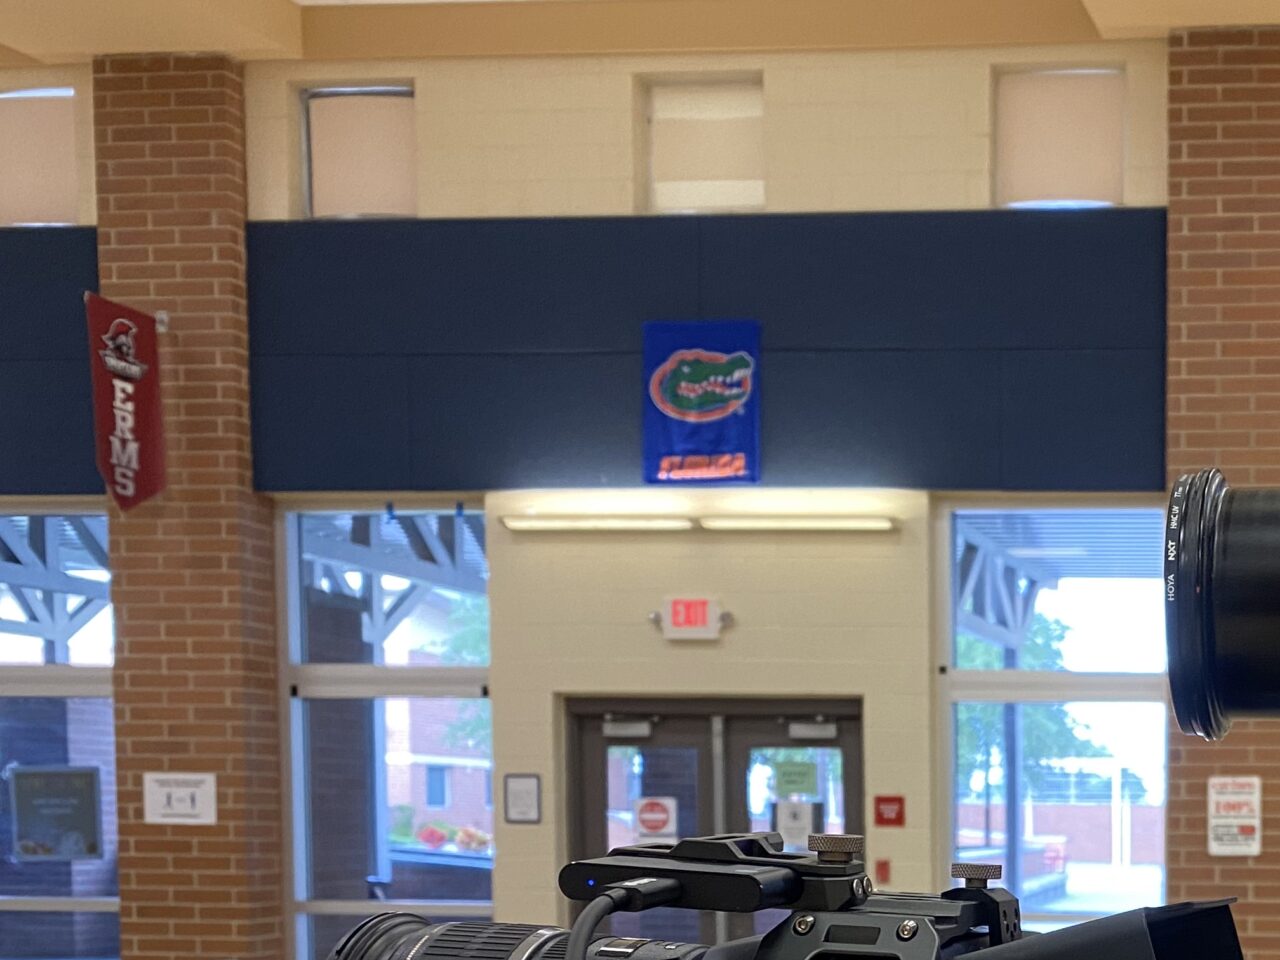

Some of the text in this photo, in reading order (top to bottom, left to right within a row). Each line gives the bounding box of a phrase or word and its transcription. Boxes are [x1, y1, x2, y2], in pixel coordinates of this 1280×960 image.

[110, 378, 140, 498] ERMS
[1172, 505, 1180, 514] UV
[1168, 540, 1177, 561] NXT
[1167, 574, 1175, 601] HOYA
[671, 599, 708, 628] EXIT
